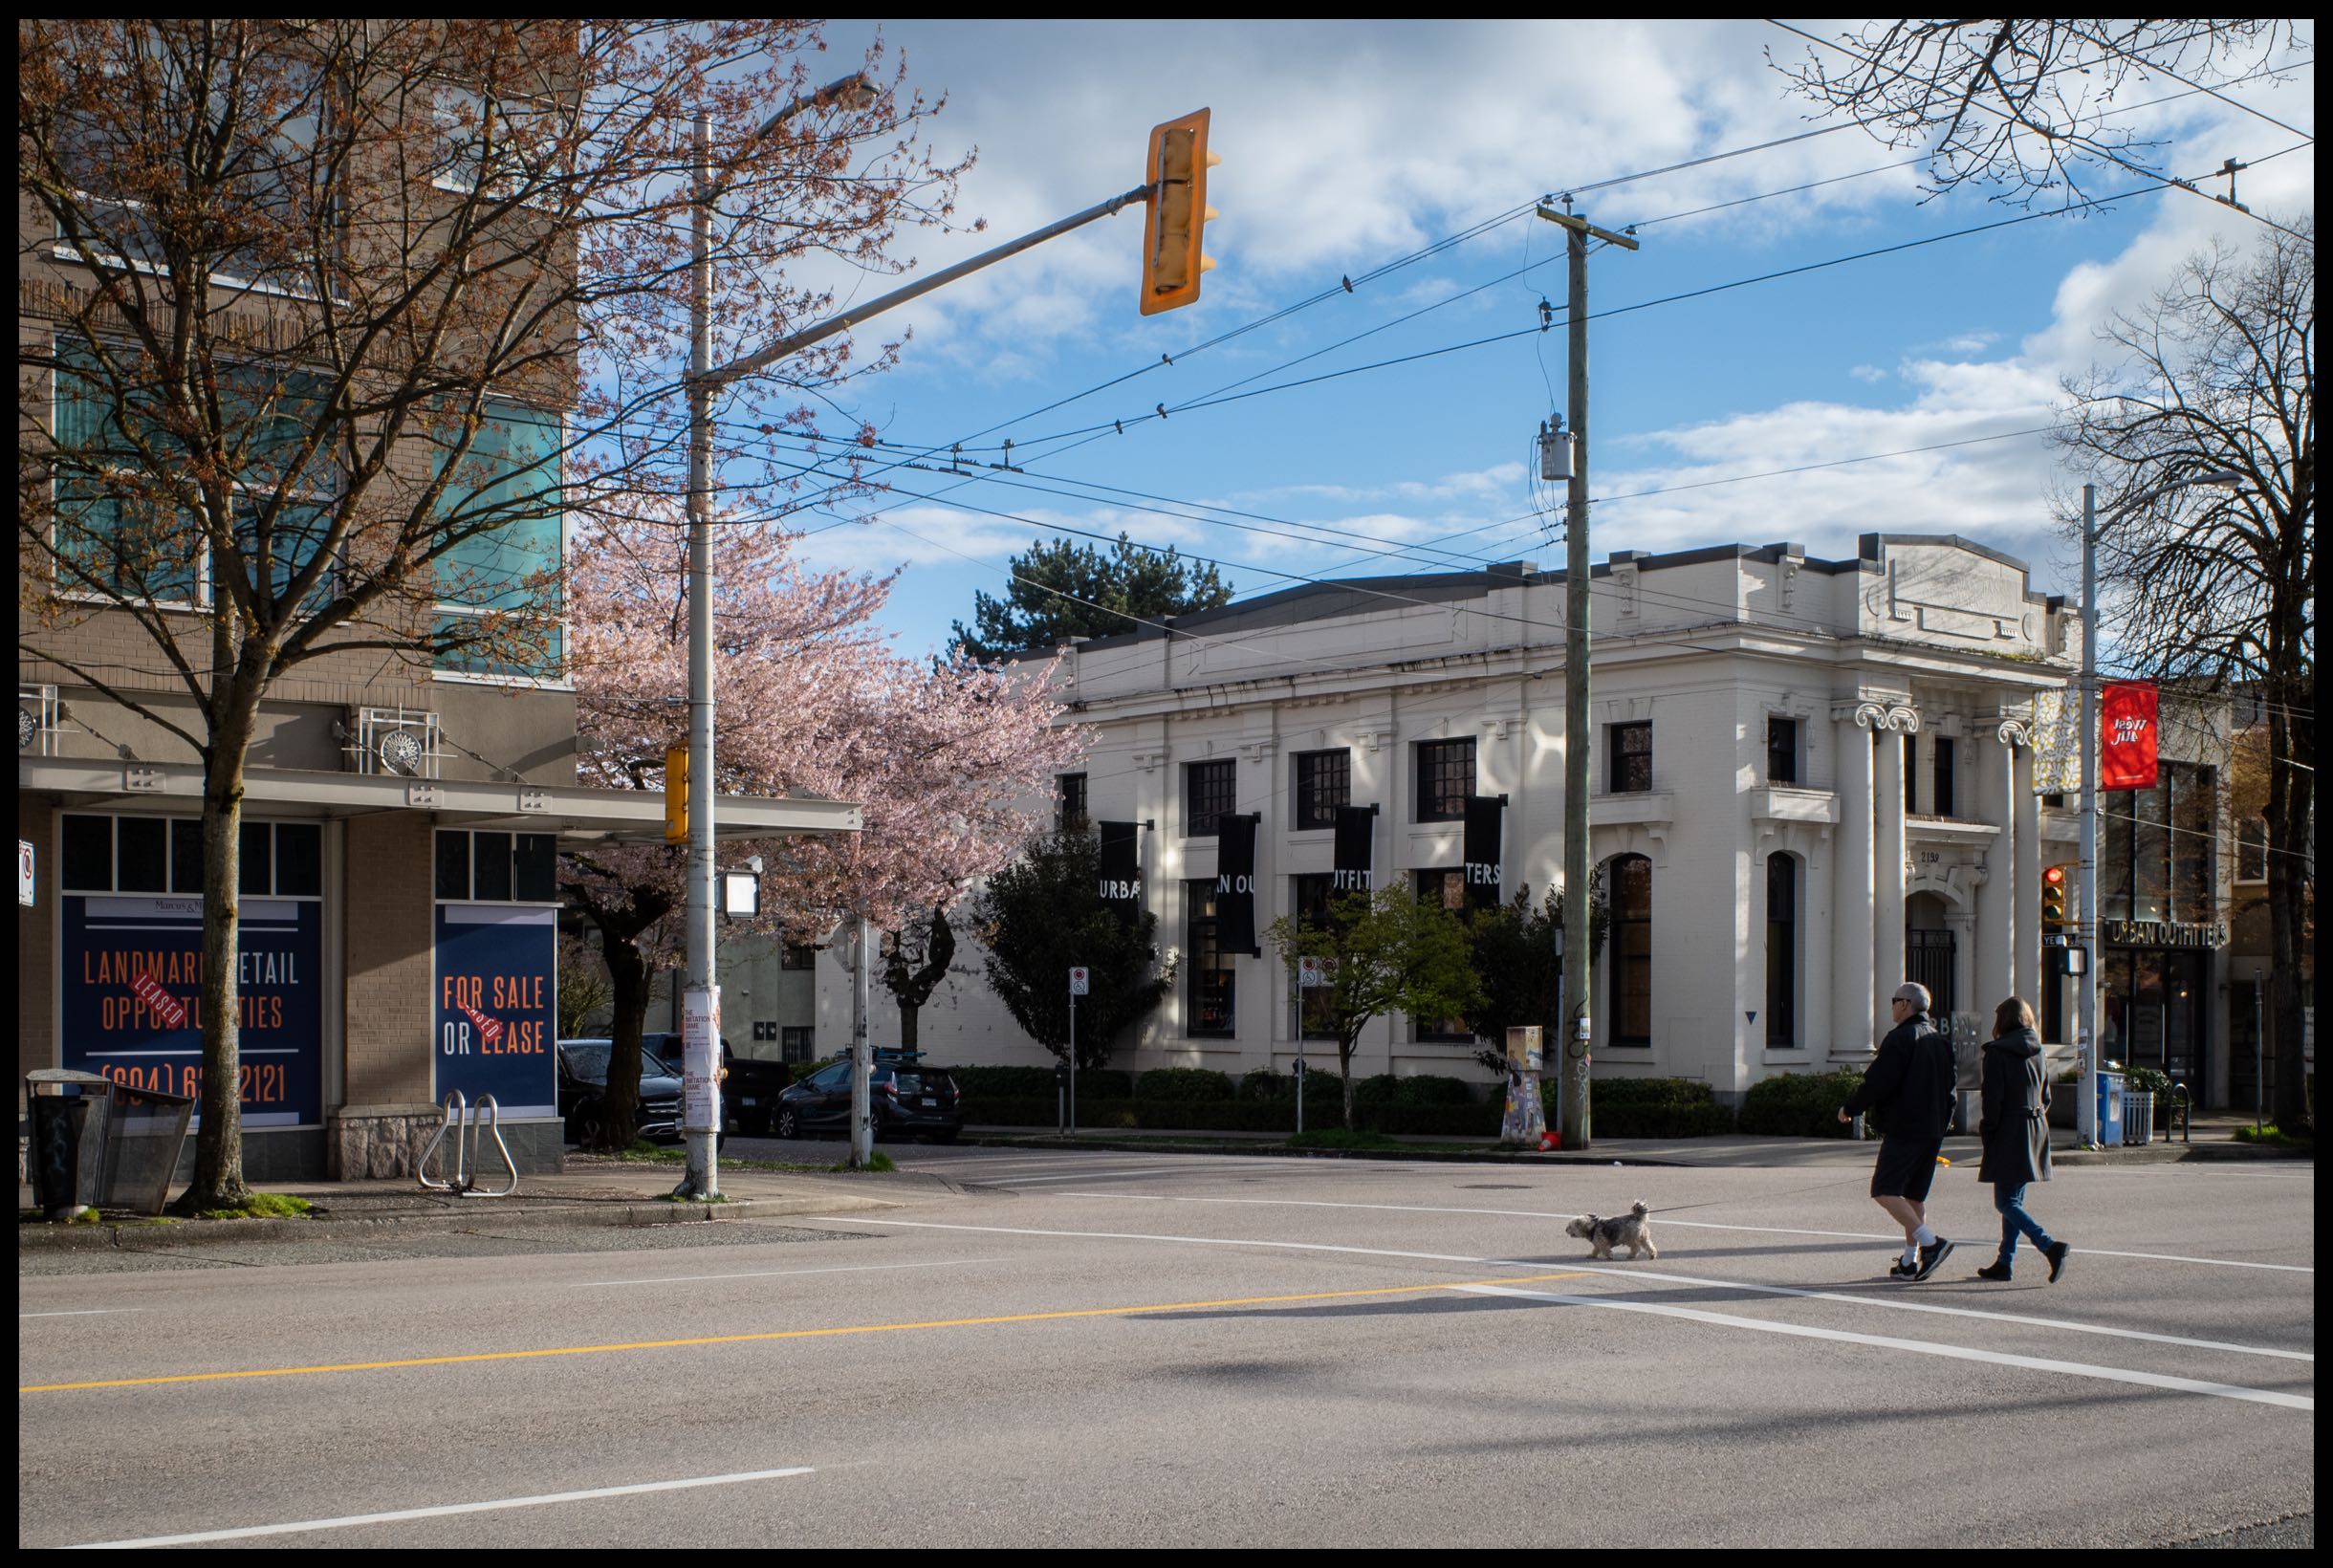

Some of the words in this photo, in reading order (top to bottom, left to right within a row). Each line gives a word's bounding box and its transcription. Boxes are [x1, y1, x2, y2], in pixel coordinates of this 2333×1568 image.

[1465, 862, 1500, 884] TERS
[155, 900, 186, 910] Marcus
[186, 902, 195, 913] &
[2112, 920, 2156, 945] URBAN
[2158, 921, 2228, 947] OUTFITTERS
[84, 950, 204, 985] LANDMAR
[240, 951, 299, 985] ETAIL
[134, 974, 184, 1025] LEASED
[444, 976, 483, 1010] FOR
[493, 976, 544, 1010] SALE
[444, 1021, 470, 1056] OR
